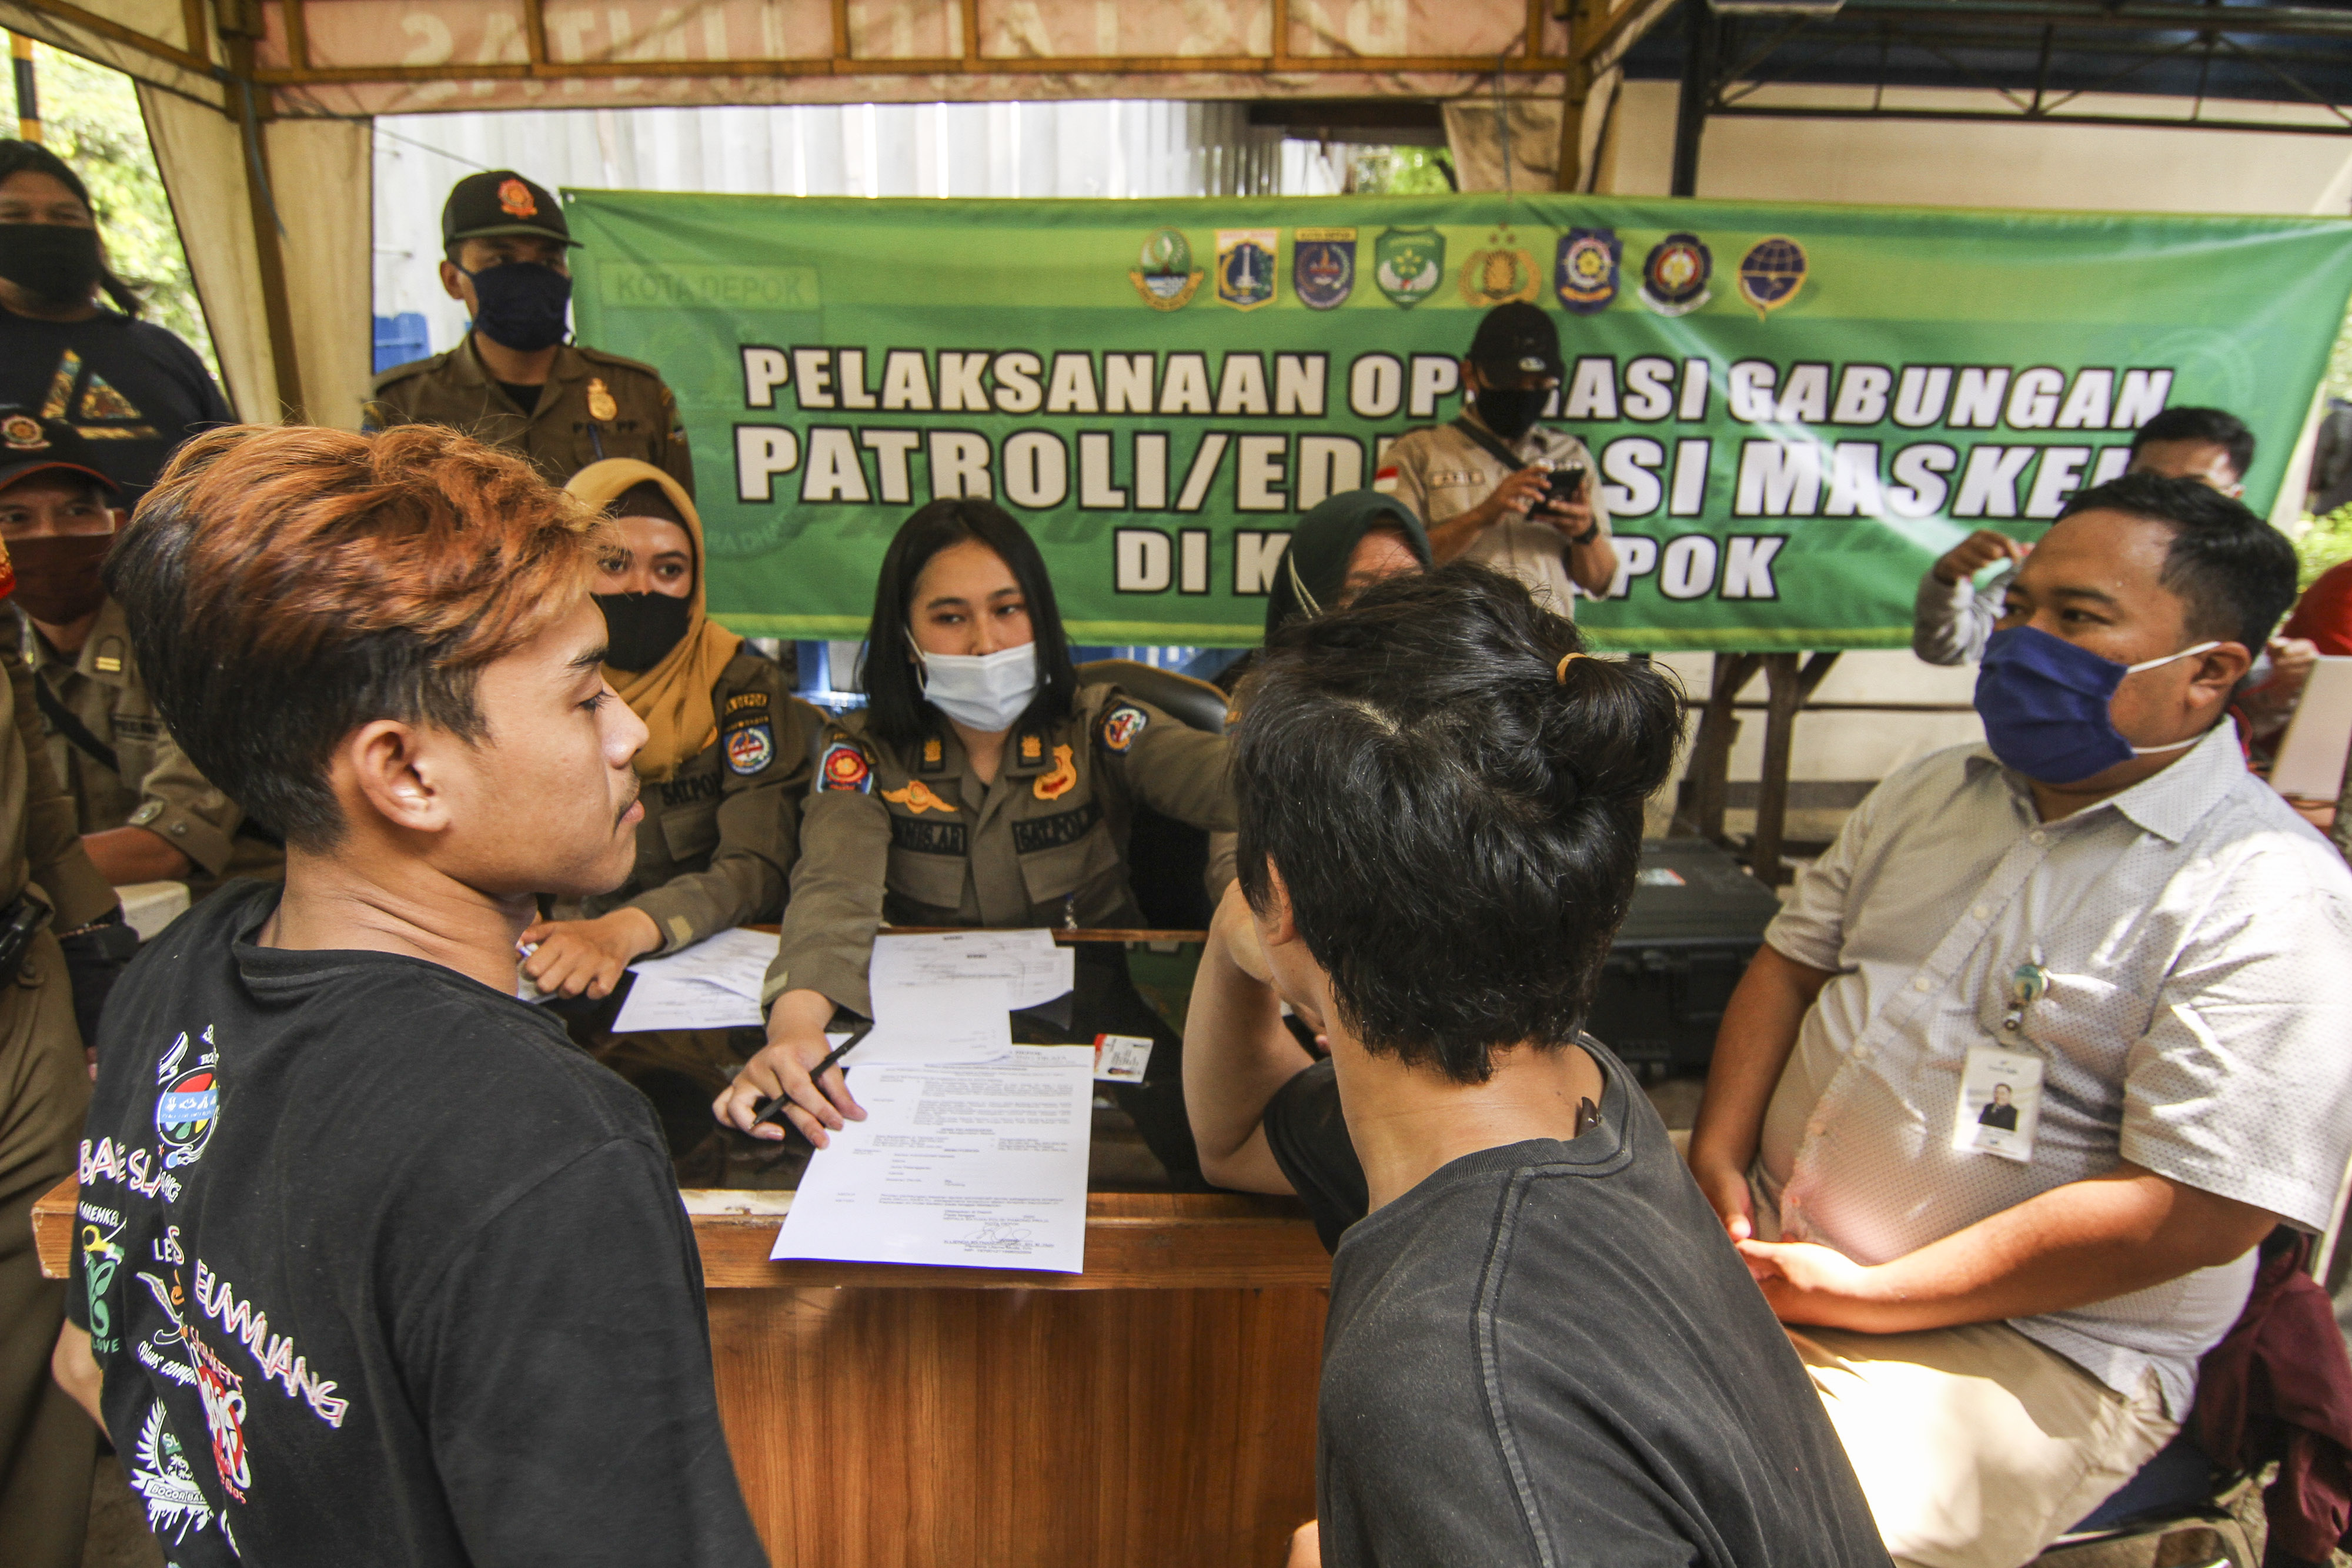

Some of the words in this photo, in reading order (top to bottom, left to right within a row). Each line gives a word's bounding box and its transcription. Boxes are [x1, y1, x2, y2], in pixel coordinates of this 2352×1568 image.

[741, 346, 1328, 415] PELAKSANAAN
[1350, 353, 1709, 422] OPASI
[1728, 360, 2174, 430] GABUNGAN
[735, 423, 1712, 520] PATROLI/EDSI
[1114, 527, 1210, 594] DI
[1576, 533, 1790, 600] POK
[151, 1485, 185, 1501] BOGOR
